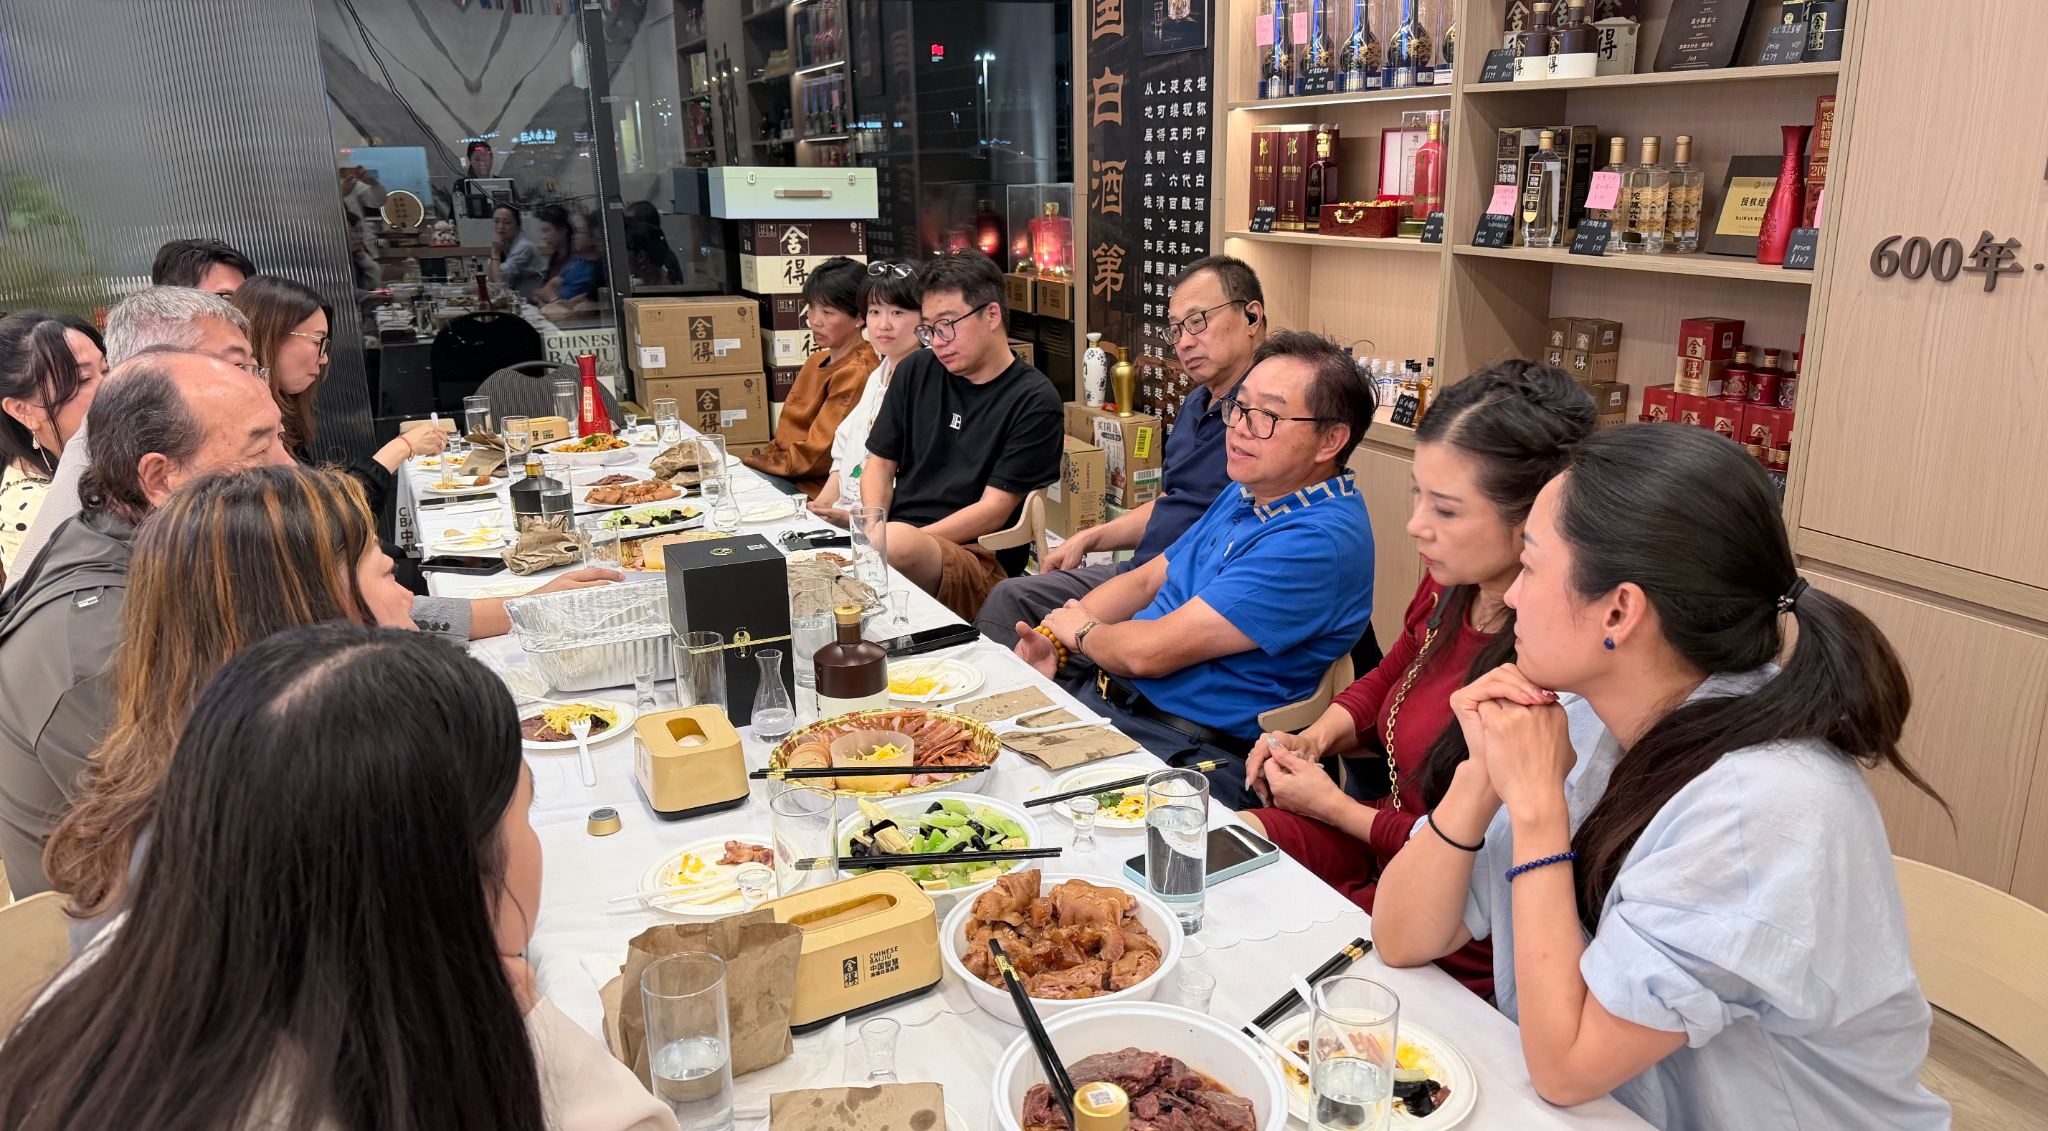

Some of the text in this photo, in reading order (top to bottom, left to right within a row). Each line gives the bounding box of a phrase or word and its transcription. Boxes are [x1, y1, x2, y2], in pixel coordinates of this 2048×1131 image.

[1514, 39, 1526, 76] 舍得
[1549, 36, 1561, 74] 舍得
[780, 225, 809, 286] 舍得
[1789, 255, 1810, 265] $107
[1792, 244, 1812, 254] price
[689, 317, 714, 363] 舍得
[1550, 330, 1564, 366] 舍得
[1574, 333, 1589, 370] 舍得
[1685, 338, 1703, 378] 舍得
[697, 390, 721, 433] 舍得
[869, 945, 899, 959] CHINESE
[869, 953, 892, 965] BAIJIU
[843, 957, 858, 987] 舍得
